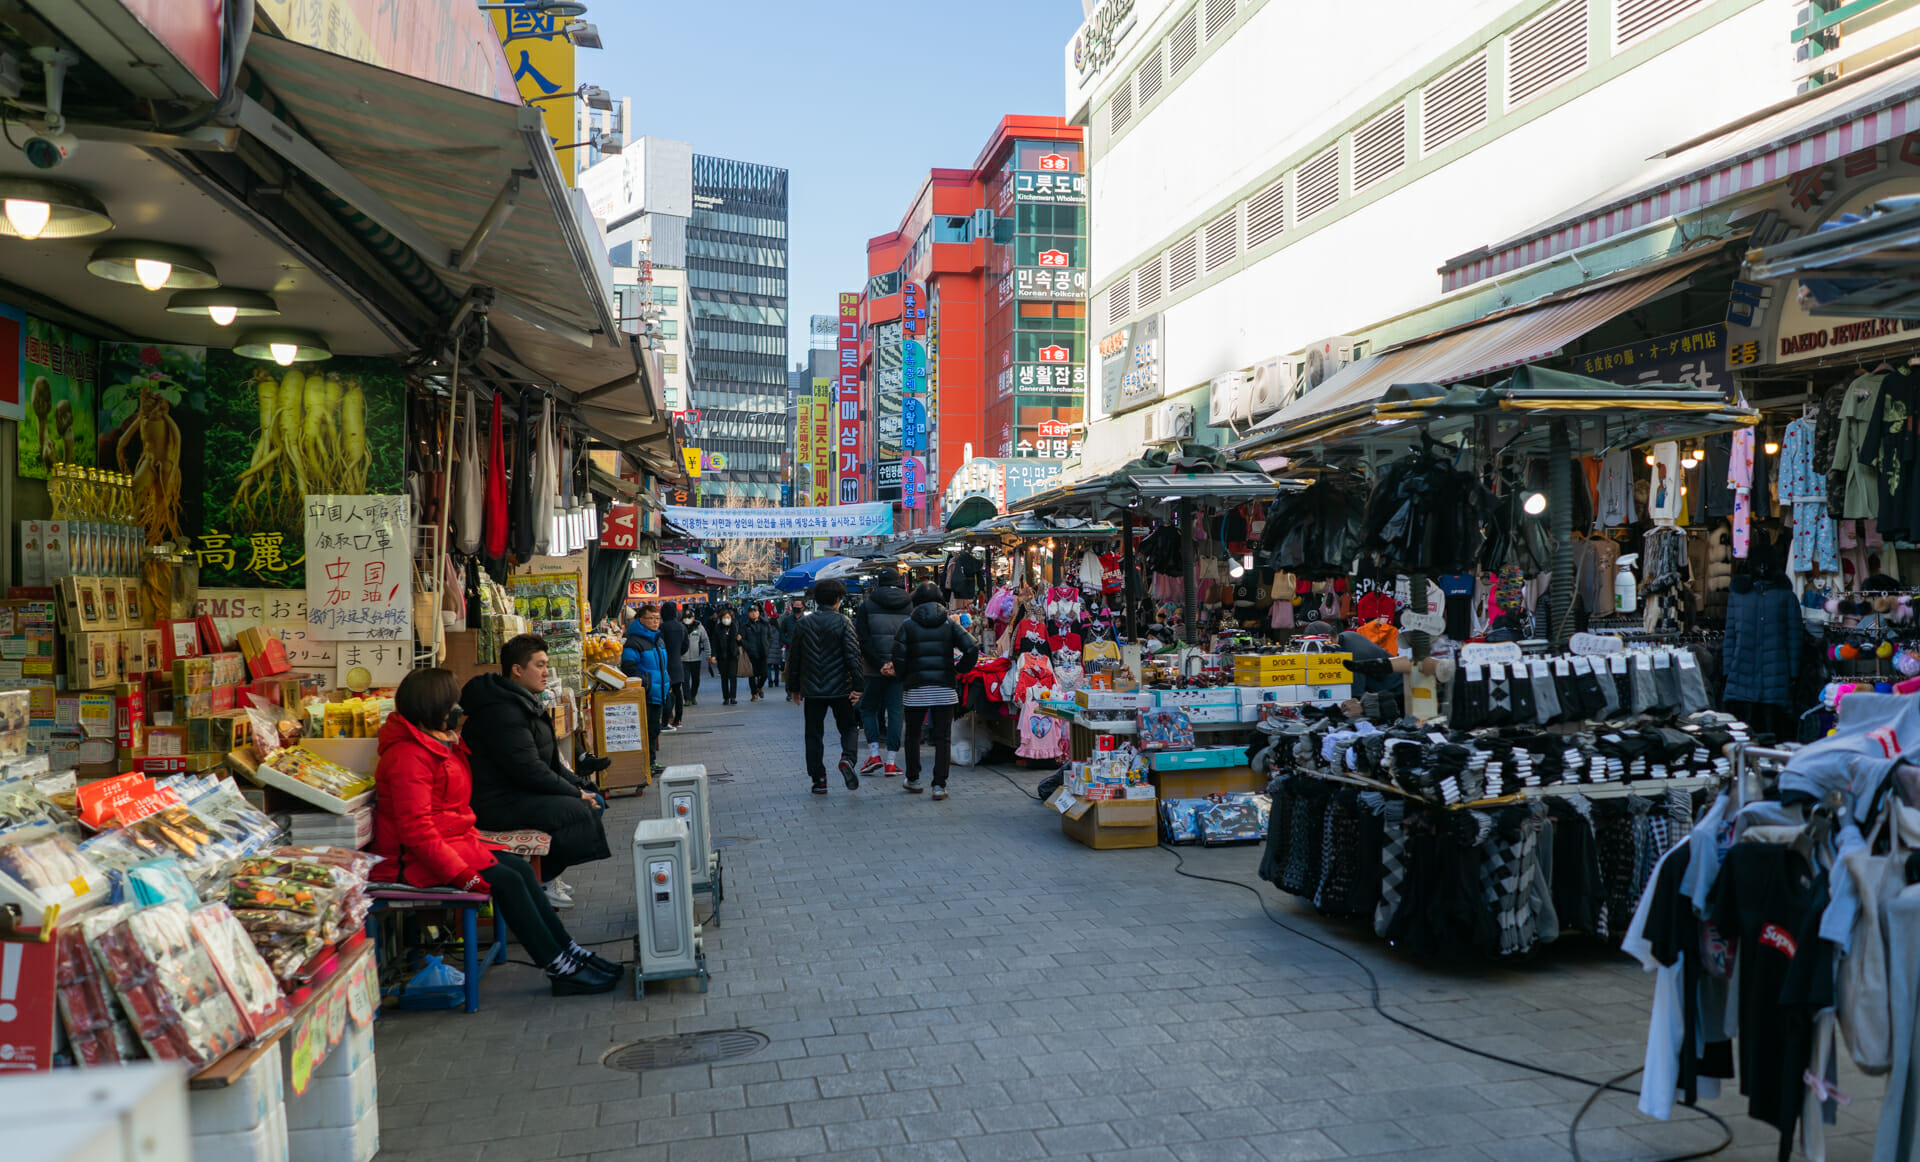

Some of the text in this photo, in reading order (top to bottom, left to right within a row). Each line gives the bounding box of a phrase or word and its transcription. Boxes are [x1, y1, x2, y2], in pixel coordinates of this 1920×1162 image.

[1042, 159, 1066, 169] 3층
[1017, 193, 1055, 201] Kitchenware
[1042, 254, 1065, 265] 2층
[1018, 289, 1047, 297] Korean
[840, 305, 857, 316] 3층
[1780, 329, 1828, 356] DAEDO
[1829, 317, 1898, 346] JEWELRY
[1043, 350, 1065, 360] 1층
[840, 322, 859, 472] 그릇도매상가
[682, 518, 709, 529] 이용하는
[711, 517, 732, 529] 시민과
[734, 517, 754, 529] 상인의
[756, 517, 777, 529] 안전을
[779, 517, 793, 529] 위해
[794, 517, 828, 529] 예방소독을
[830, 516, 857, 528] 실시하고
[324, 556, 386, 588] 中国
